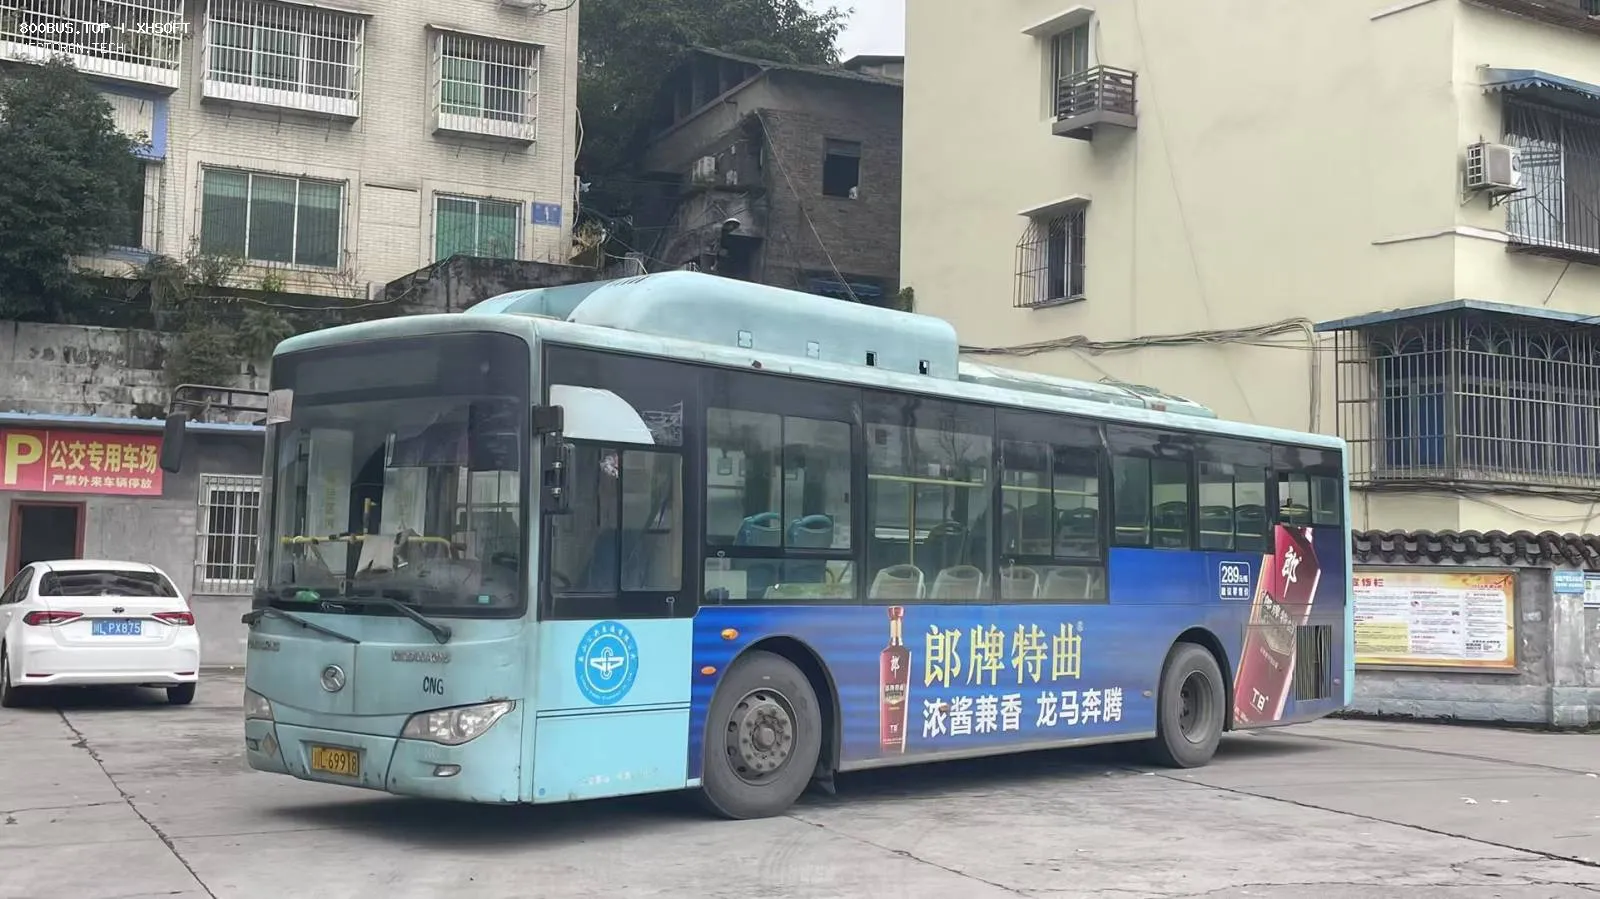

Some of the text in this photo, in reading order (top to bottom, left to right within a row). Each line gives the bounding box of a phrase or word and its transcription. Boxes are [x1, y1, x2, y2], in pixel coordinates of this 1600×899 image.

[4, 433, 43, 485] P
[50, 440, 158, 475] 公交专用车场
[52, 474, 152, 489] 严禁外来车辆停放
[923, 622, 1084, 688] 郎牌特曲
[422, 676, 444, 695] CNG
[922, 686, 1124, 739] 浓酱兼香 龙马奔腾
